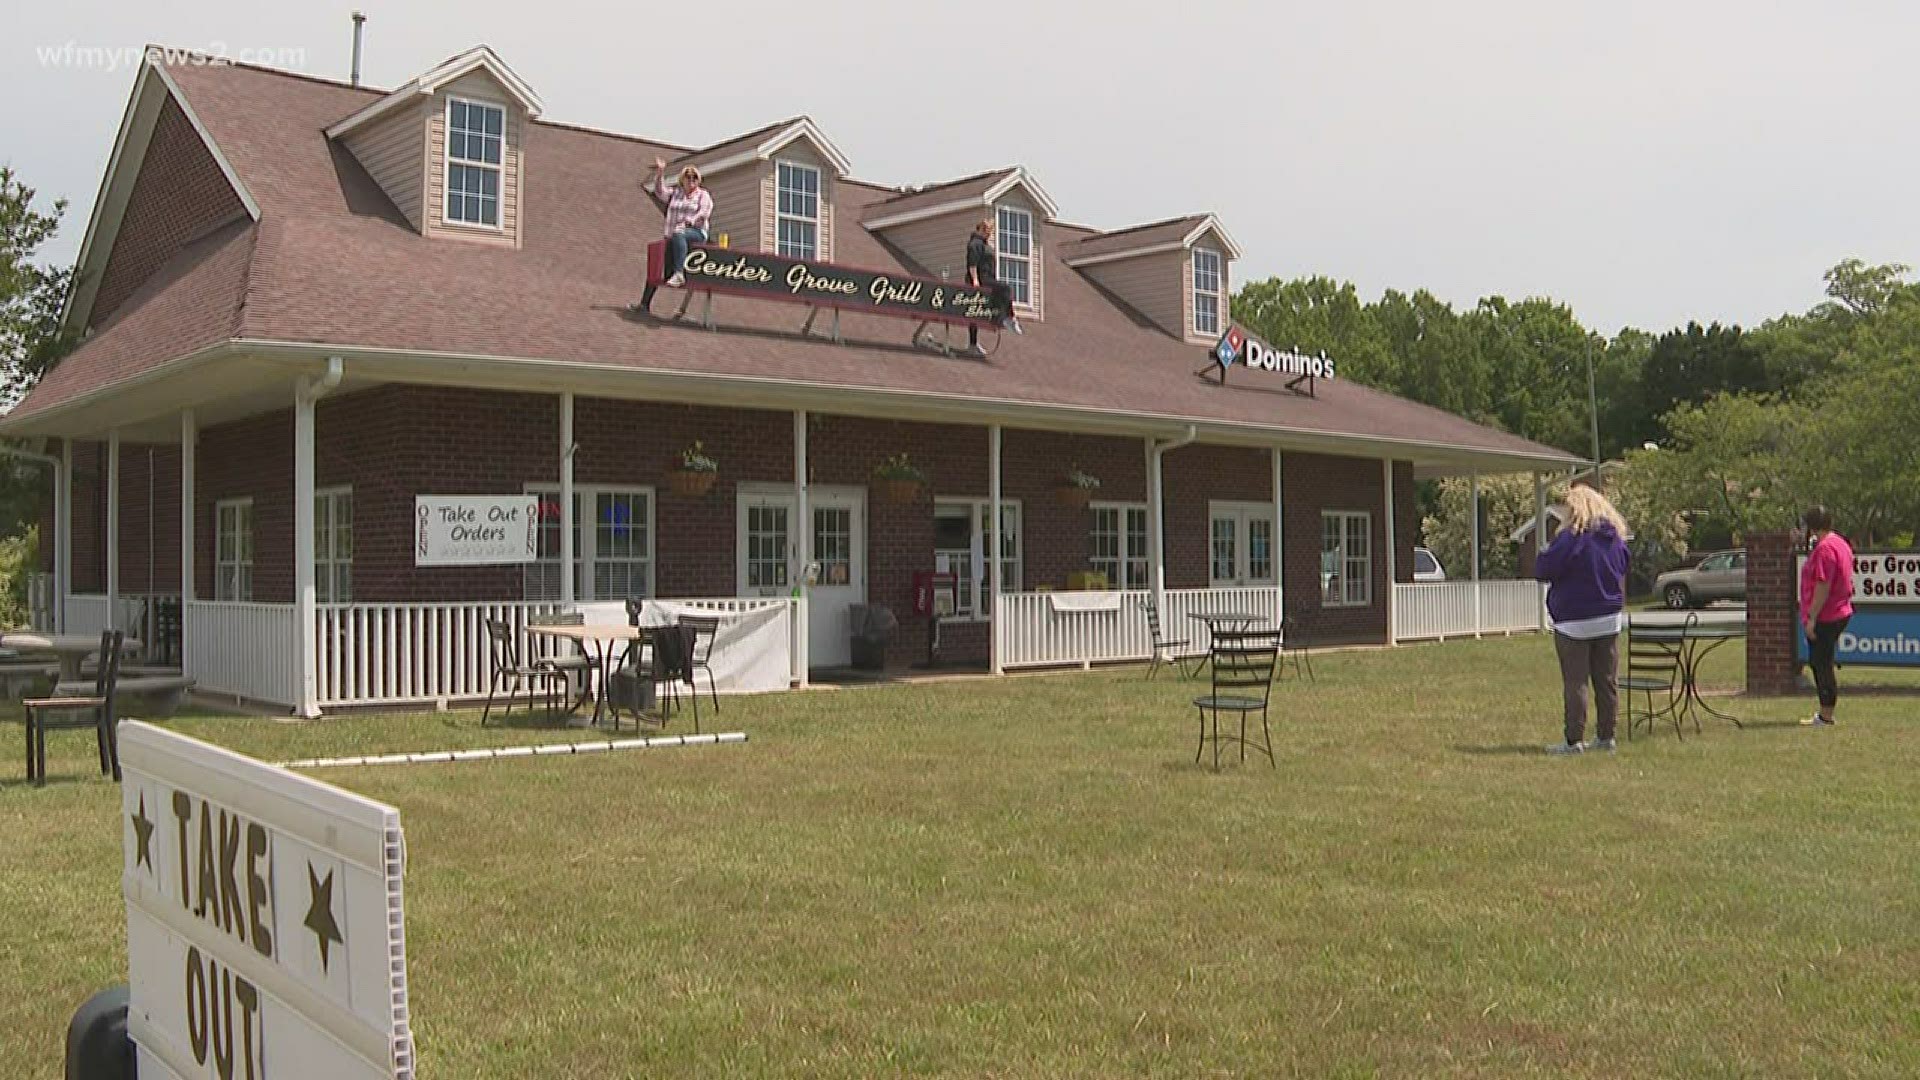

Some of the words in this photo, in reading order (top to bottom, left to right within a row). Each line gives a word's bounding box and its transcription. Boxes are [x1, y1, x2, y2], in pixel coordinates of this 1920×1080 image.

[682, 247, 773, 283] Center
[786, 264, 859, 294] Grove
[870, 276, 923, 304] Grill
[931, 288, 944, 309] &
[1246, 339, 1335, 378] Domino's
[417, 504, 429, 557] OPEN
[437, 504, 476, 523] Take
[487, 505, 518, 522] Out
[450, 523, 505, 541] Orders
[525, 503, 537, 554] OPEN
[1853, 557, 1878, 574] ter
[1864, 578, 1907, 596] Soda
[172, 789, 273, 958] TAKE
[186, 945, 258, 1080] OUT
